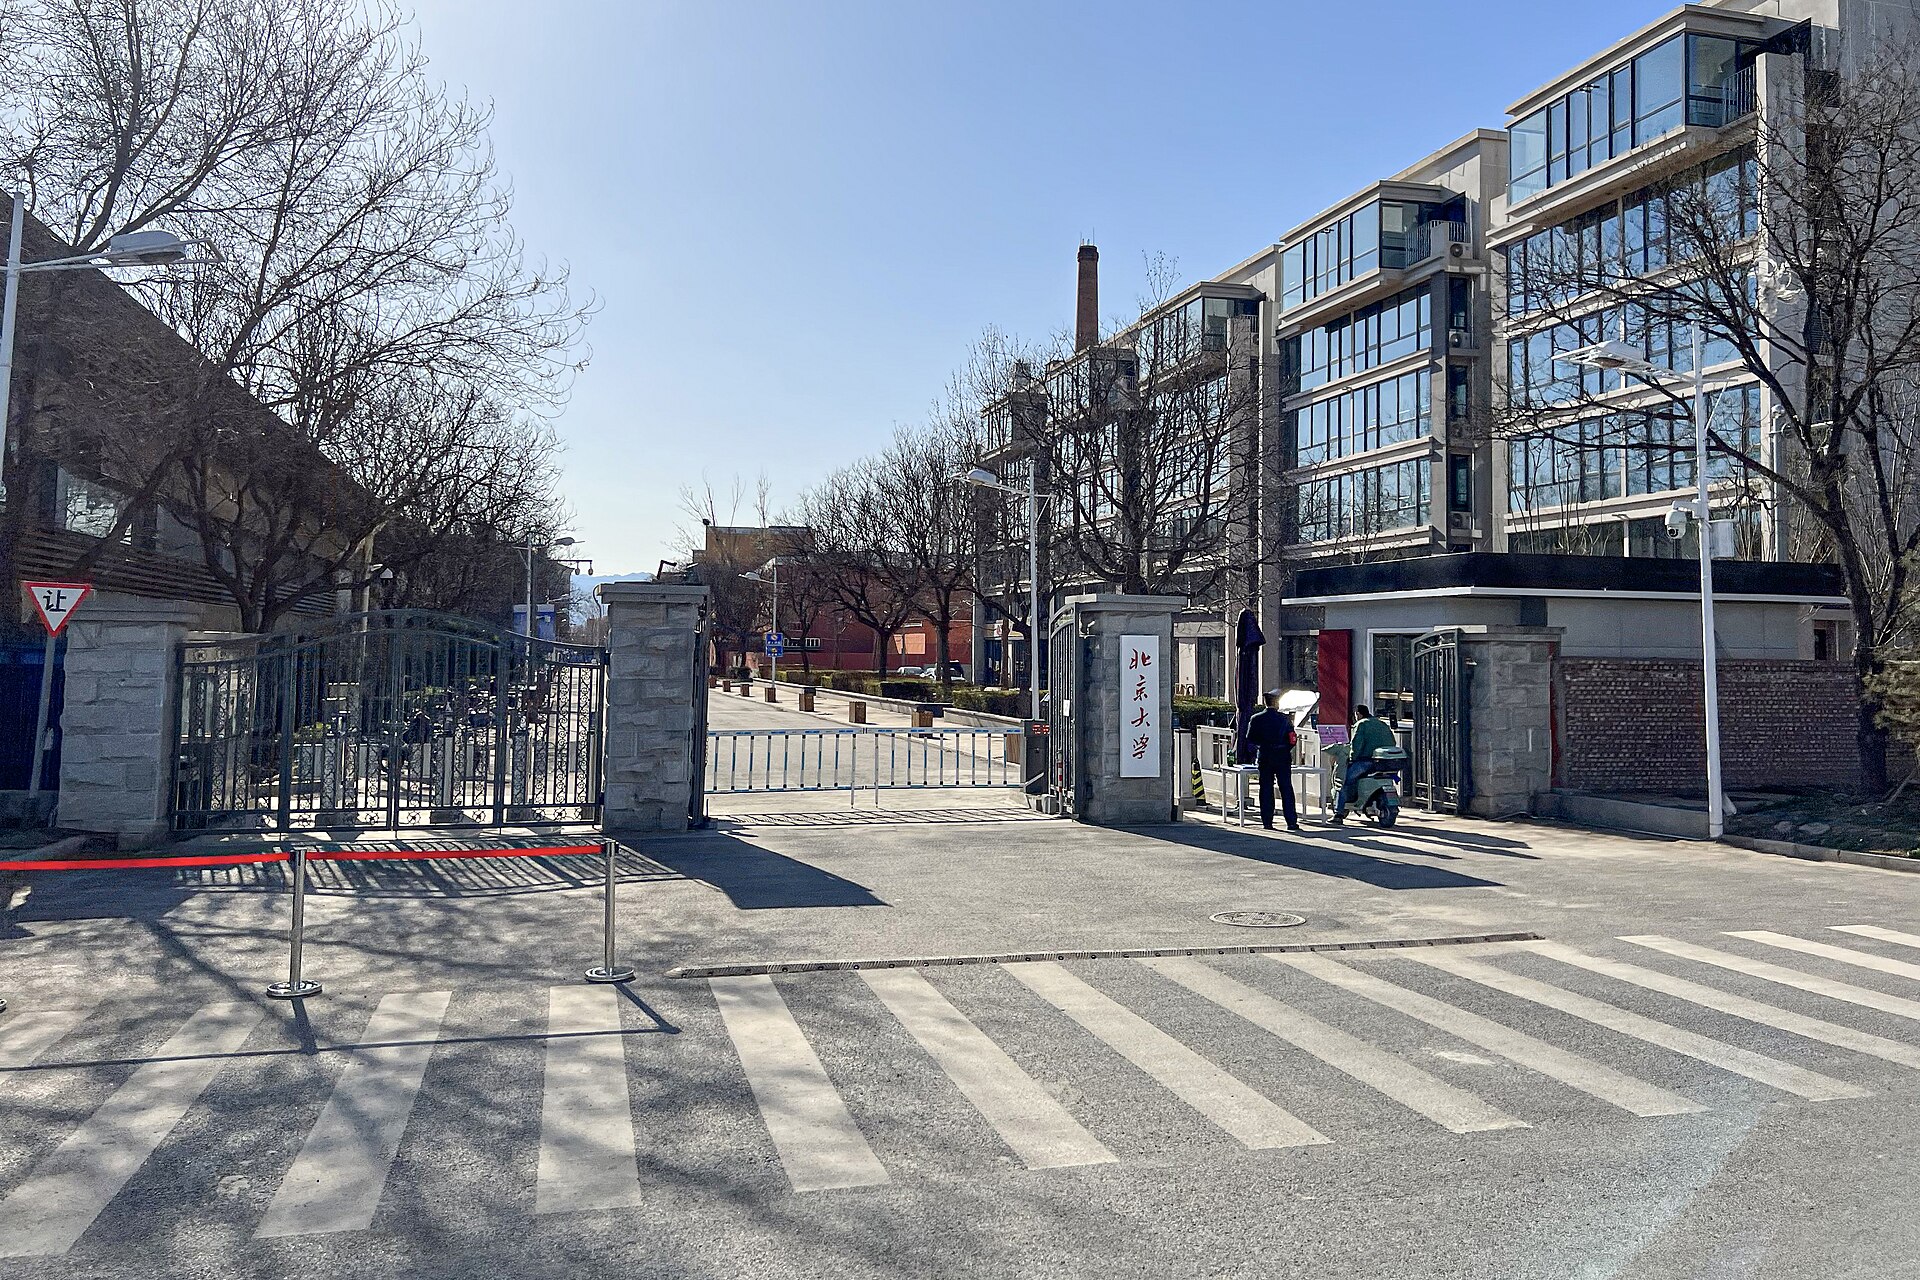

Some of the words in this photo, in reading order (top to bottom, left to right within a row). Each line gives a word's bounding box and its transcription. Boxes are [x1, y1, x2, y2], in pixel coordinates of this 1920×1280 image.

[43, 590, 67, 612] 让
[1129, 648, 1151, 759] 北京大学
